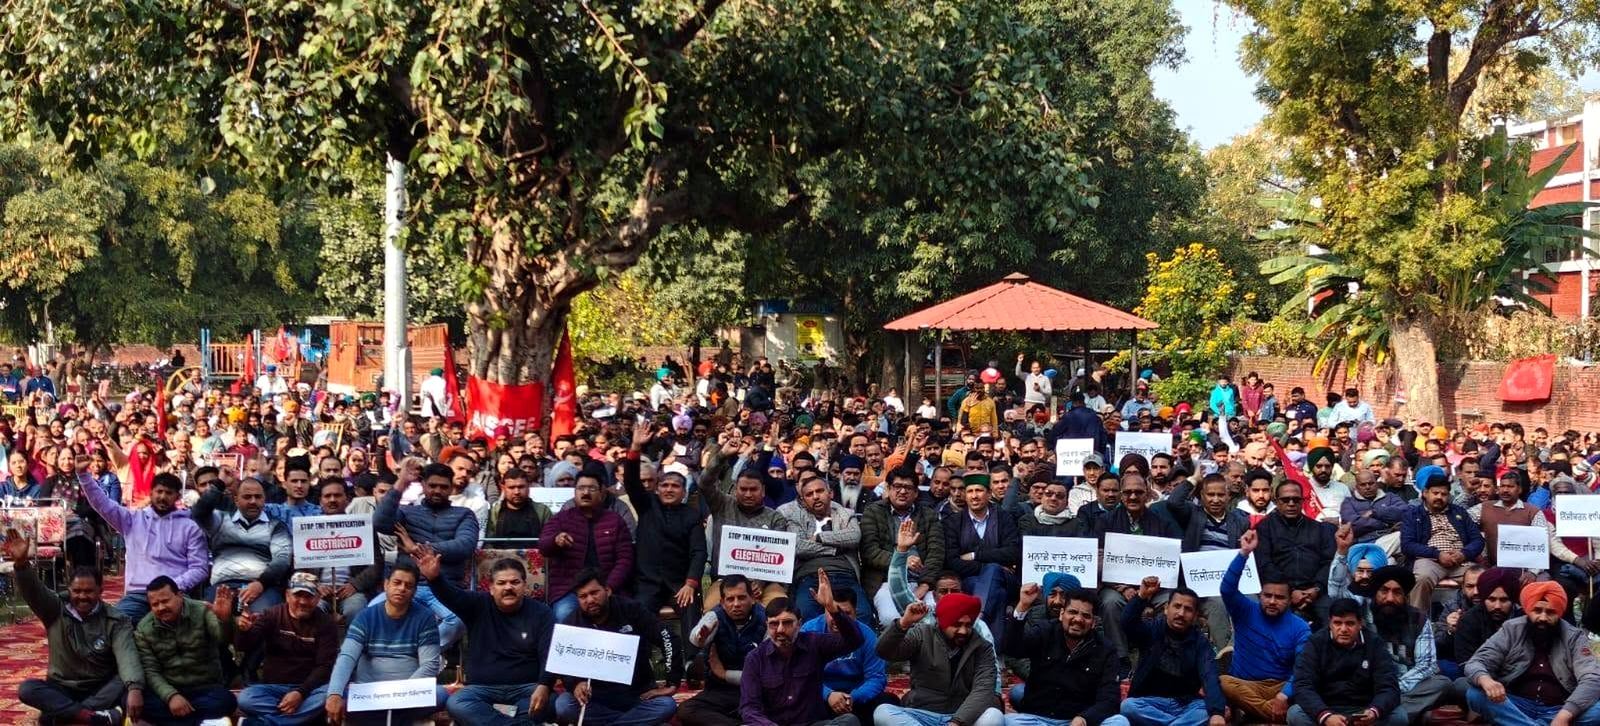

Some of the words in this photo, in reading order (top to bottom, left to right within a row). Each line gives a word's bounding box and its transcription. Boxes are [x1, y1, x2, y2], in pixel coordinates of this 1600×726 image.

[300, 522, 314, 530] STOP
[315, 522, 325, 530] THE
[326, 520, 366, 529] PRIVATIZATION
[309, 537, 358, 550] ELECTRICITY
[728, 532, 741, 540] STOP
[742, 533, 751, 541] THE
[751, 534, 789, 545] PRIVATIZATION
[734, 549, 781, 565] ELECTRICITY
[1051, 551, 1068, 561] ਵਾਲੇ
